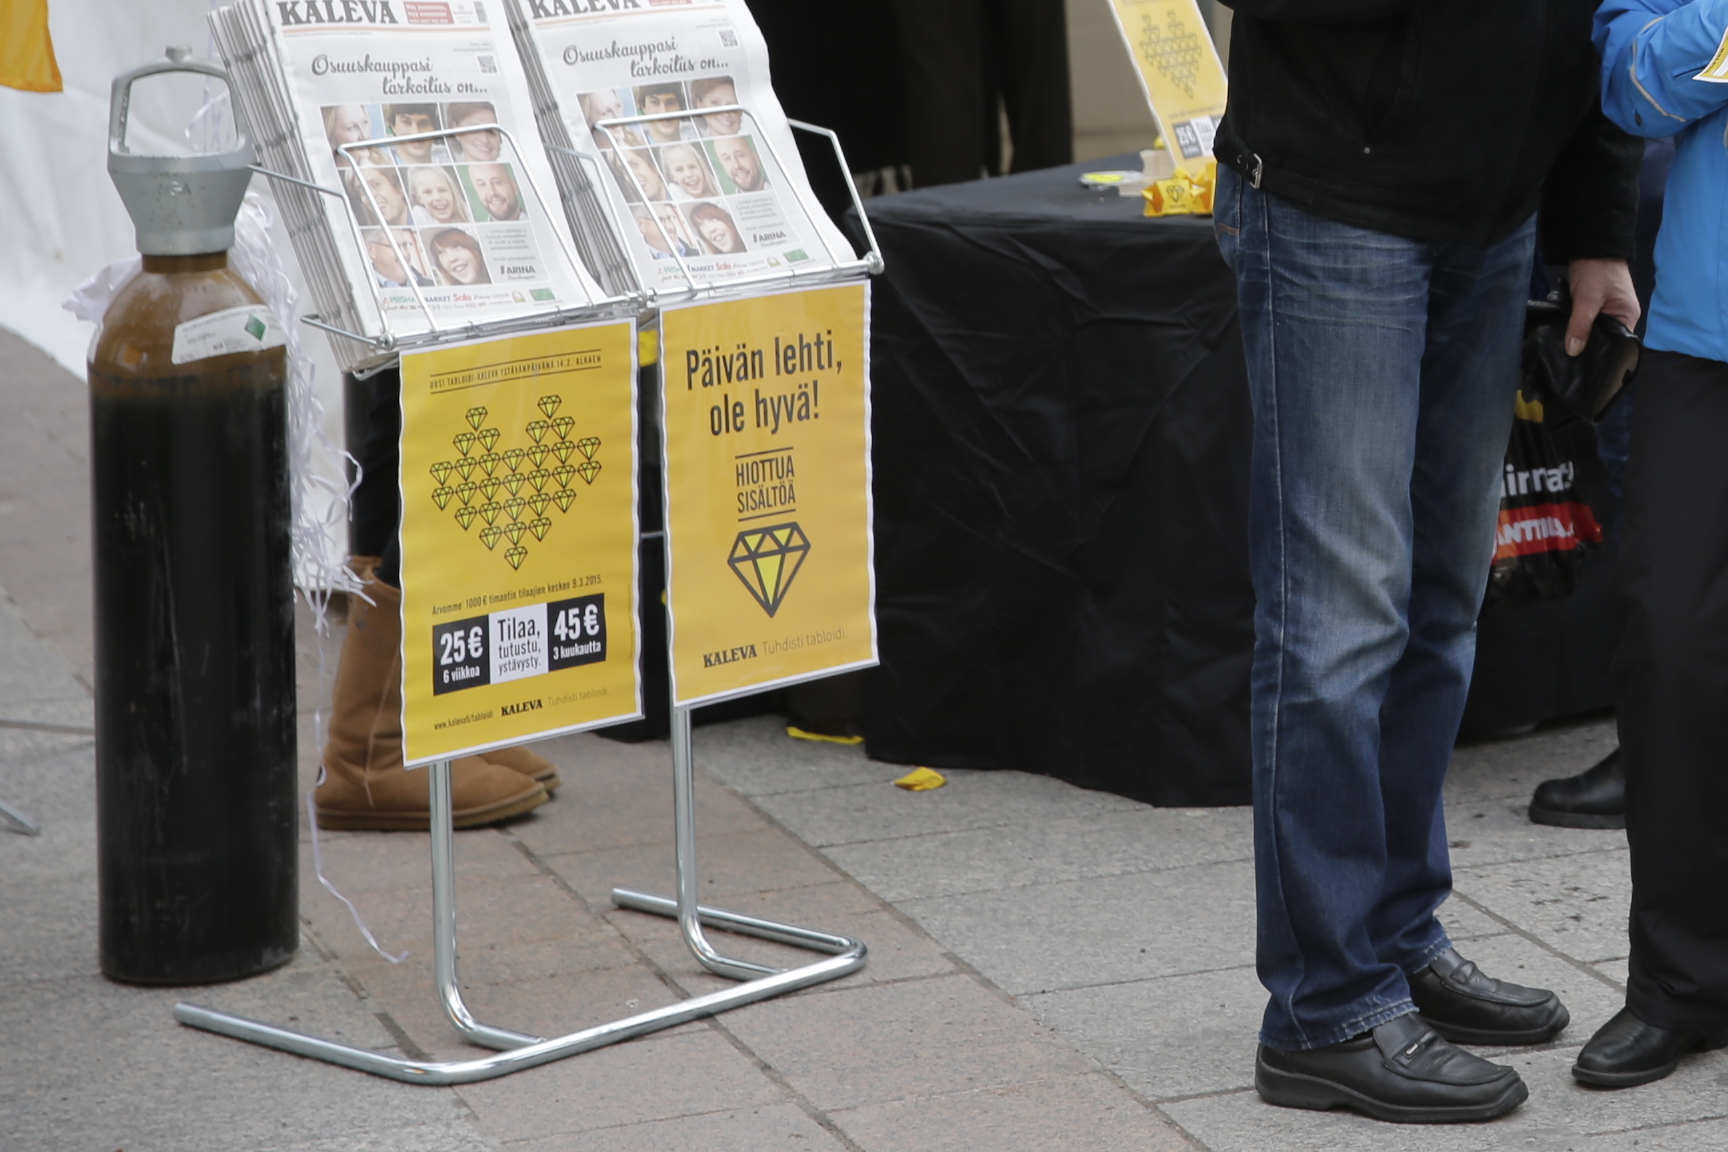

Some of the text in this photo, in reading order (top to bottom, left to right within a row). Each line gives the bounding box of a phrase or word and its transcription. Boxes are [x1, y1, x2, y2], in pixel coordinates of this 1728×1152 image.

[276, 0, 398, 26] KALEVA
[563, 36, 679, 65] Osuuskauppasi
[311, 53, 434, 79] Osuuskauppasi
[630, 55, 729, 78] tarkoitus on...
[382, 76, 488, 95] tarkoitus on...
[430, 380, 445, 389] UUSI
[575, 355, 601, 365] ALKAEN
[686, 329, 842, 391] Päivän lehti,
[710, 379, 819, 436] ole hyvä!
[735, 455, 795, 487] HIOTTUA
[737, 479, 796, 513] SISÄLTÖÄ
[489, 592, 517, 604] timantin
[518, 586, 546, 599] tilaajien
[547, 581, 570, 594] kesken
[497, 617, 541, 642] Tilaa,
[498, 640, 541, 659] tutustu,
[553, 641, 601, 660] 3 kuukautta
[703, 626, 848, 668] KALEVA Tuhdisti tabloidi.
[443, 665, 480, 683] 6 viikkoa
[498, 657, 541, 676] ystävysty.
[501, 687, 609, 717] KALEVA Tuhdisti tabloidi.
